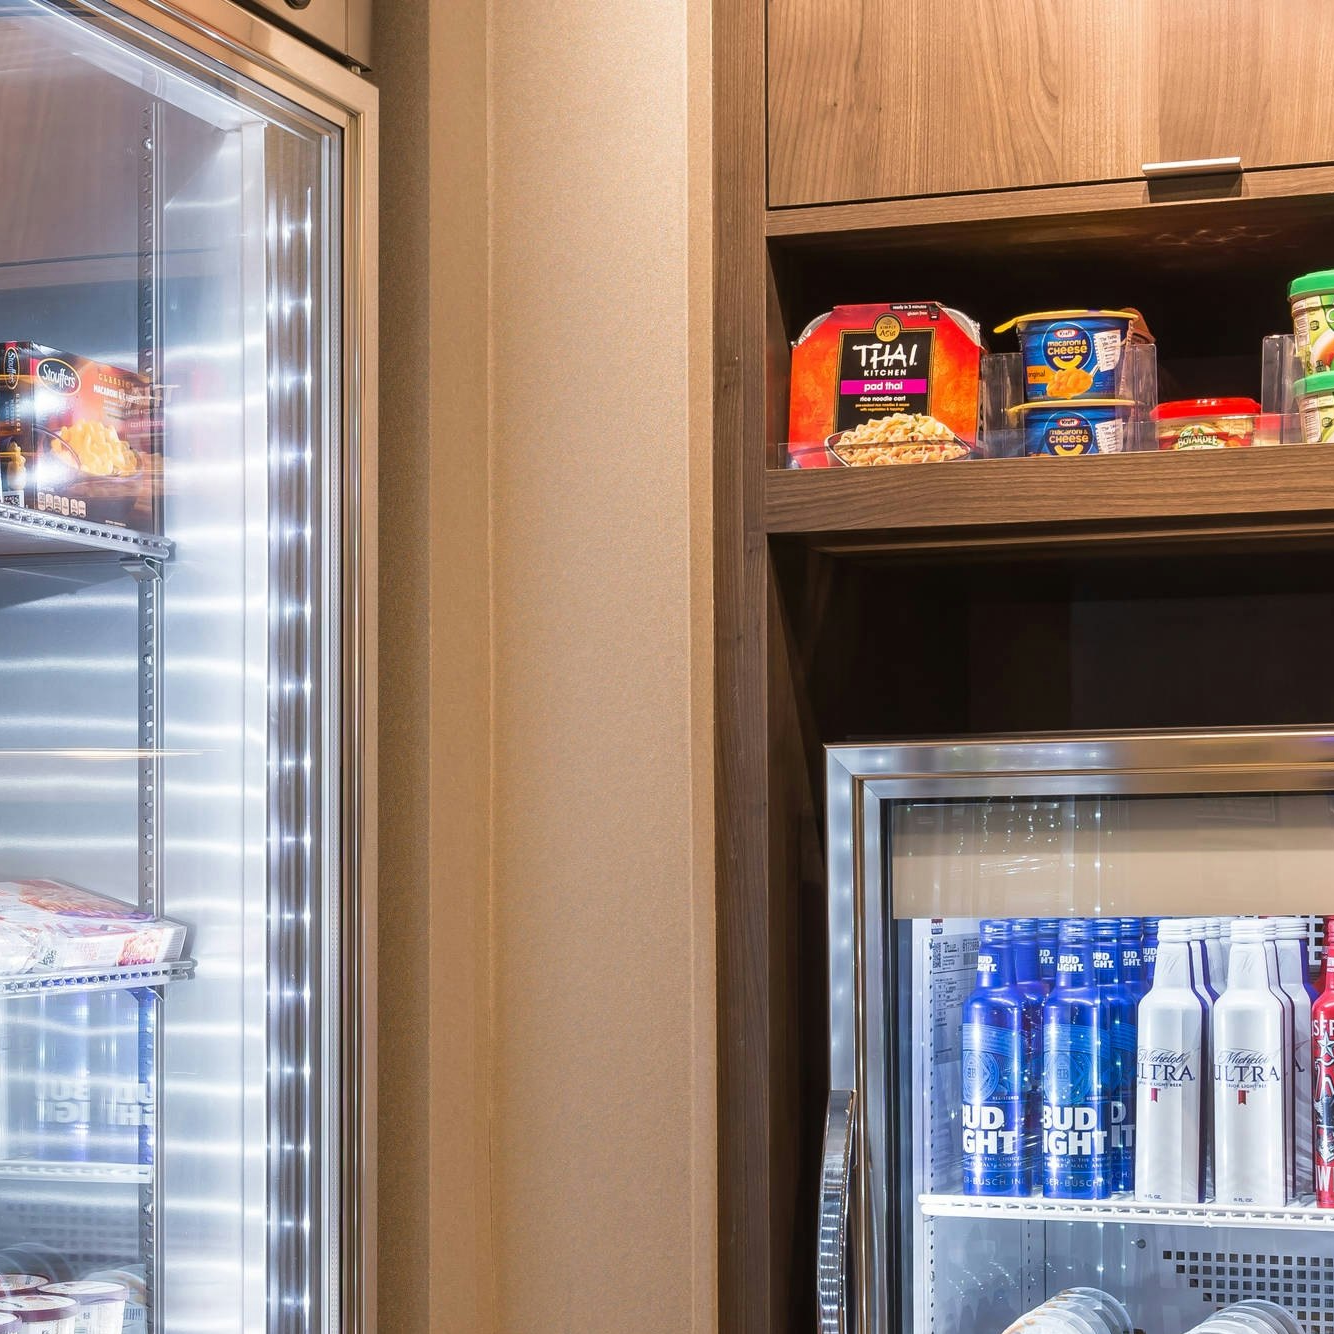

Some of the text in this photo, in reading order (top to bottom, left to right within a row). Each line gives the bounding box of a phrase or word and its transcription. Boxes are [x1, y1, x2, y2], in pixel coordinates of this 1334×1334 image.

[1047, 339, 1081, 347] macaroni
[41, 363, 77, 389] Stouffer's
[863, 369, 907, 377] KITCHEN
[864, 381, 903, 392] pad thai
[1059, 955, 1080, 964] BUD
